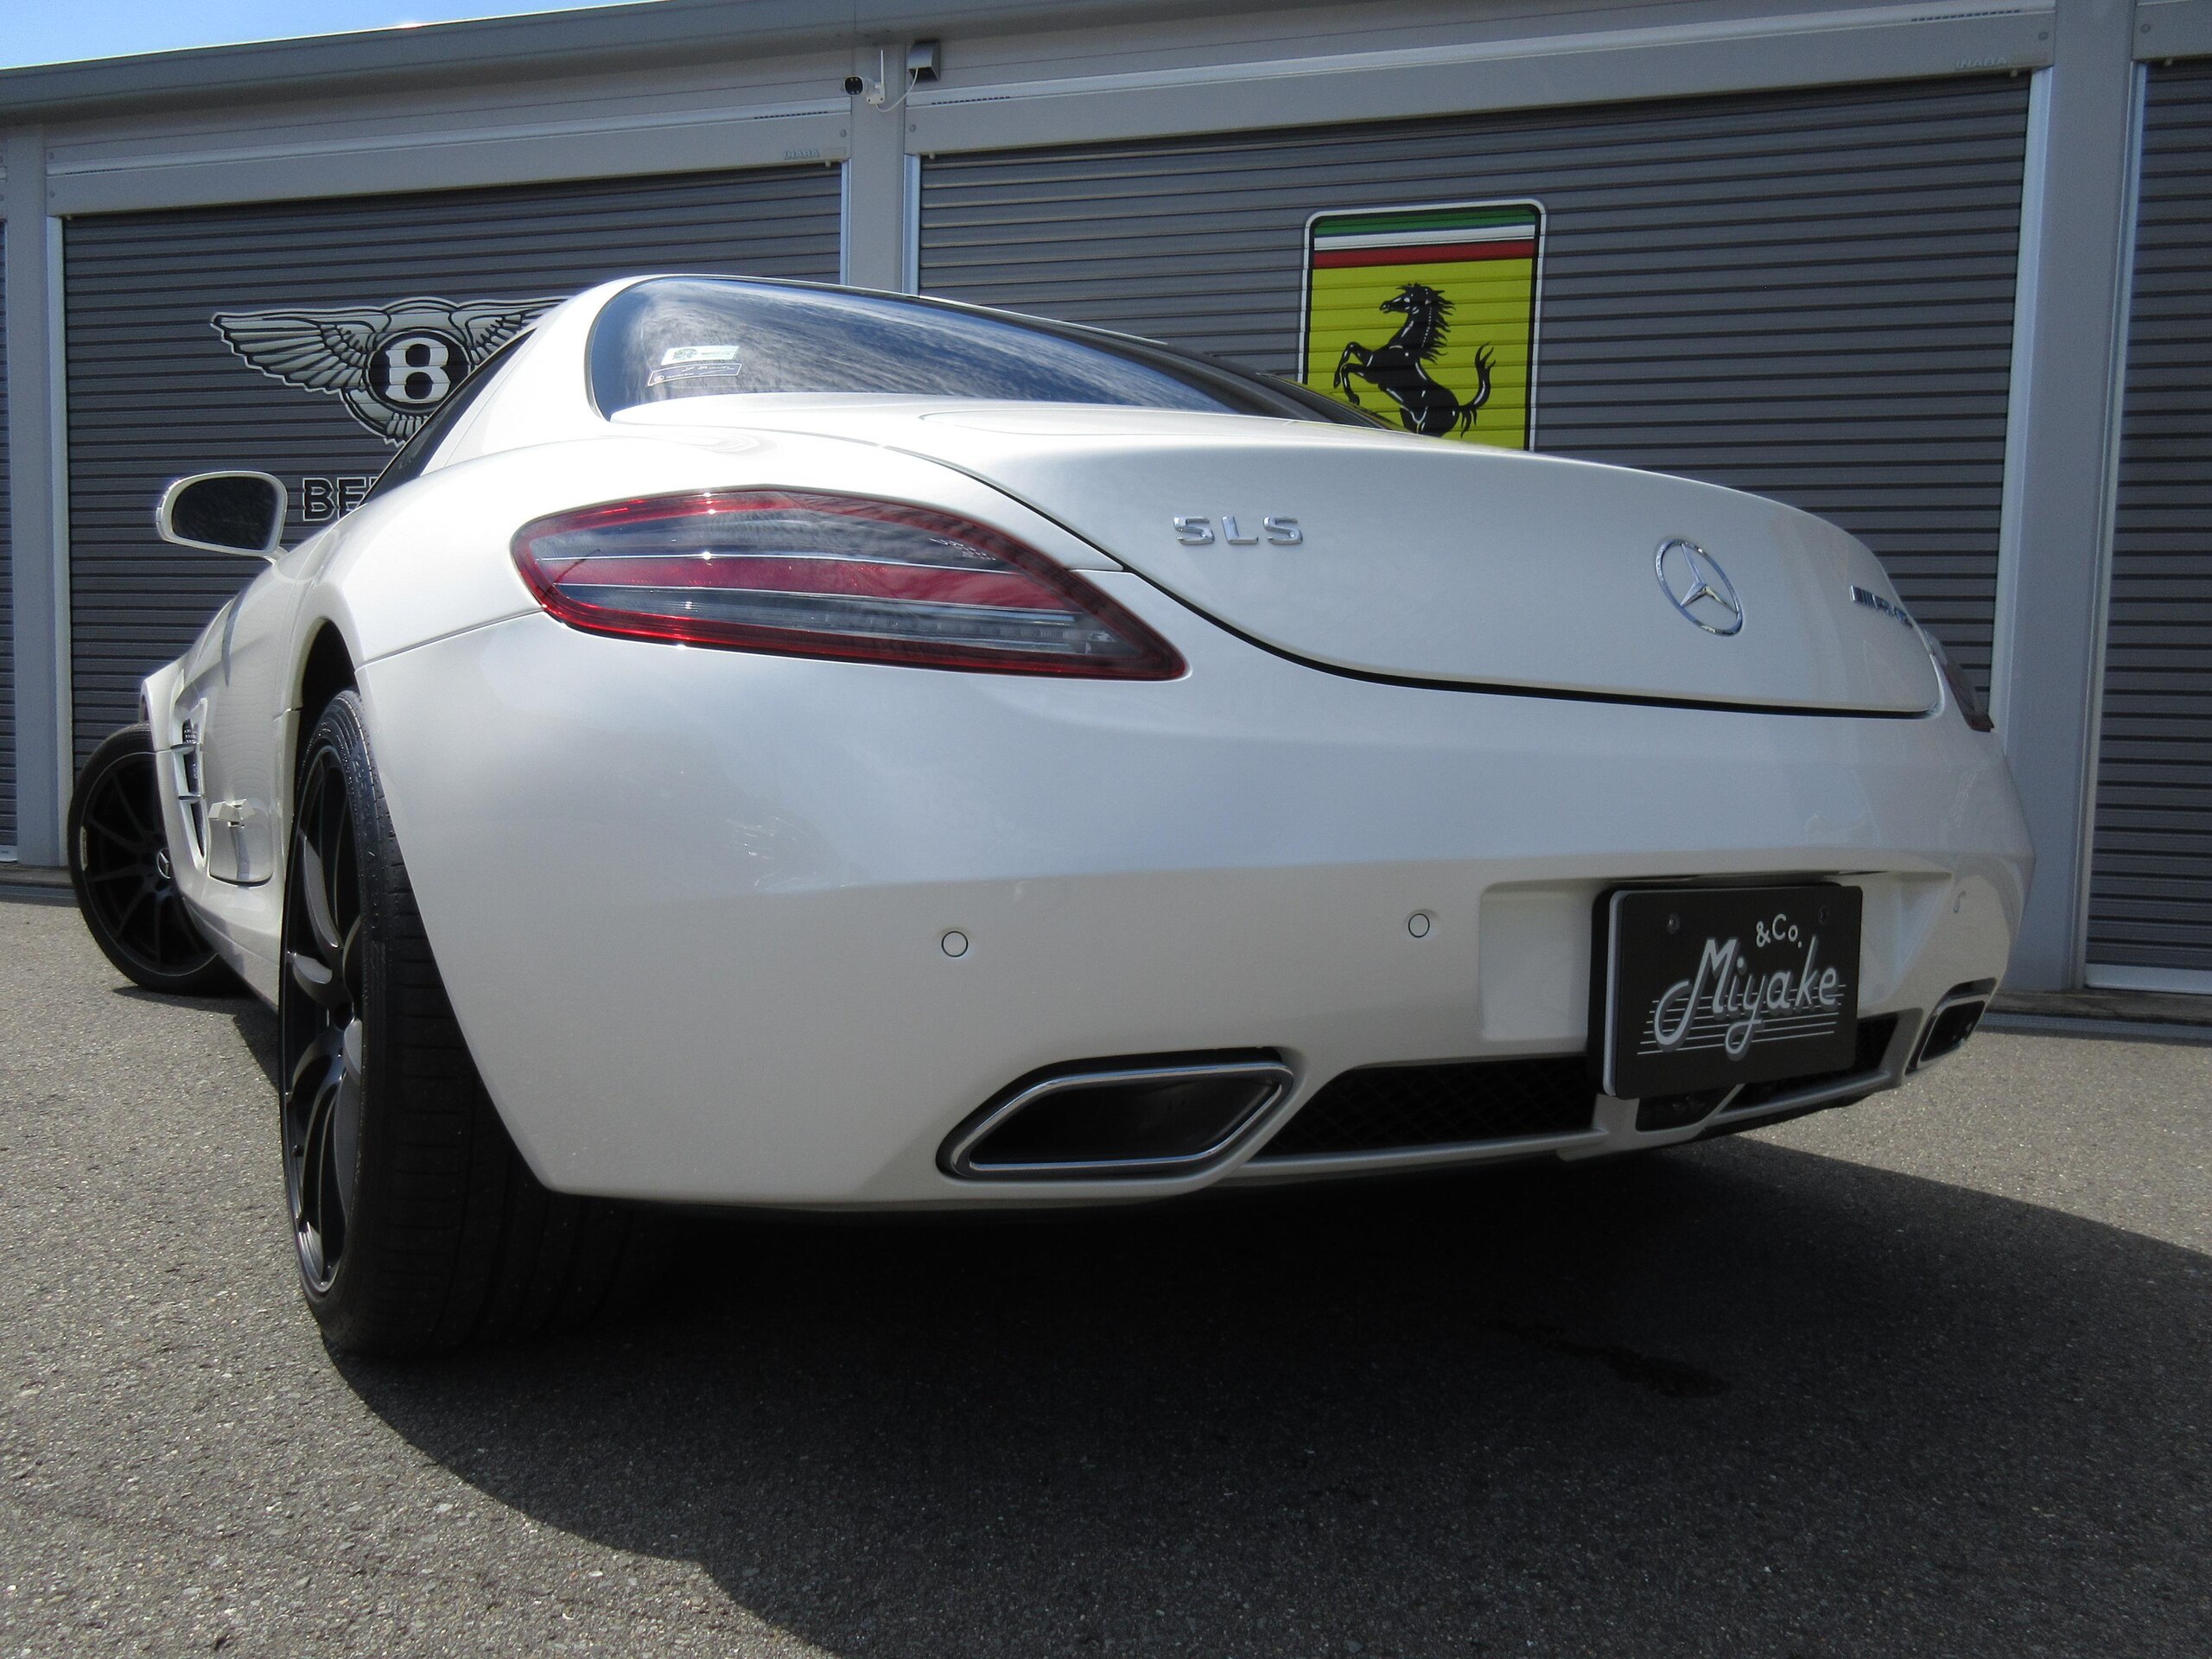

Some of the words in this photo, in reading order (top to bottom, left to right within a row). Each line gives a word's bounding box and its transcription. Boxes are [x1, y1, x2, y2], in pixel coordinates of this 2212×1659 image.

[385, 337, 450, 404] B
[302, 476, 380, 521] BE
[1173, 516, 1303, 545] SLS
[1756, 913, 1802, 948] &Co.
[1654, 935, 1838, 1059] Miyake
